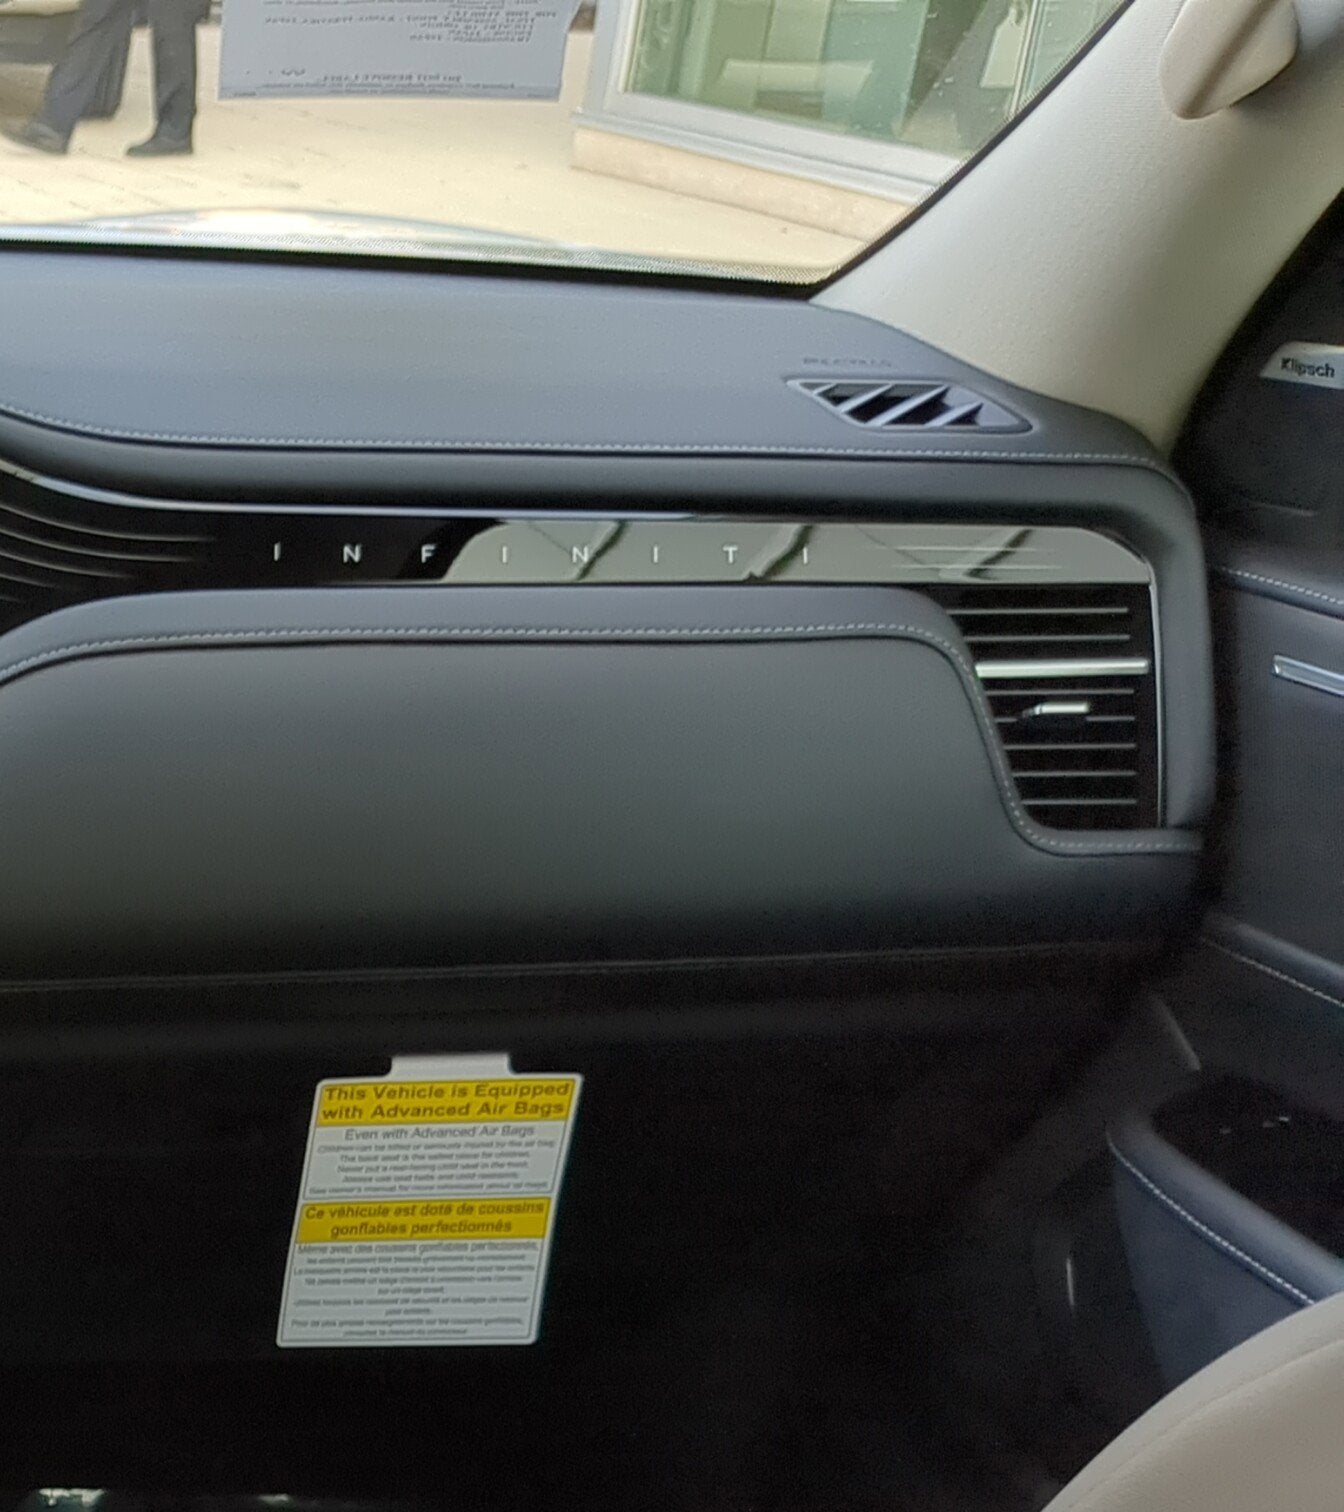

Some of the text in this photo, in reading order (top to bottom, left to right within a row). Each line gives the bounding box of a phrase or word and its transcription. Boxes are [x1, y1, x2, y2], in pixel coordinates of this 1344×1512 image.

[1280, 357, 1336, 378] Klipsch
[273, 542, 809, 565] INFINITI
[324, 1082, 570, 1101] This Vehicle is Equipped
[322, 1100, 565, 1119] with Advanced Air Bags
[344, 1124, 535, 1141] Even with Advanced Air Bags
[305, 1202, 544, 1220] Ce véhicule est doté de coussins
[331, 1219, 513, 1239] gonflables perfectionnés
